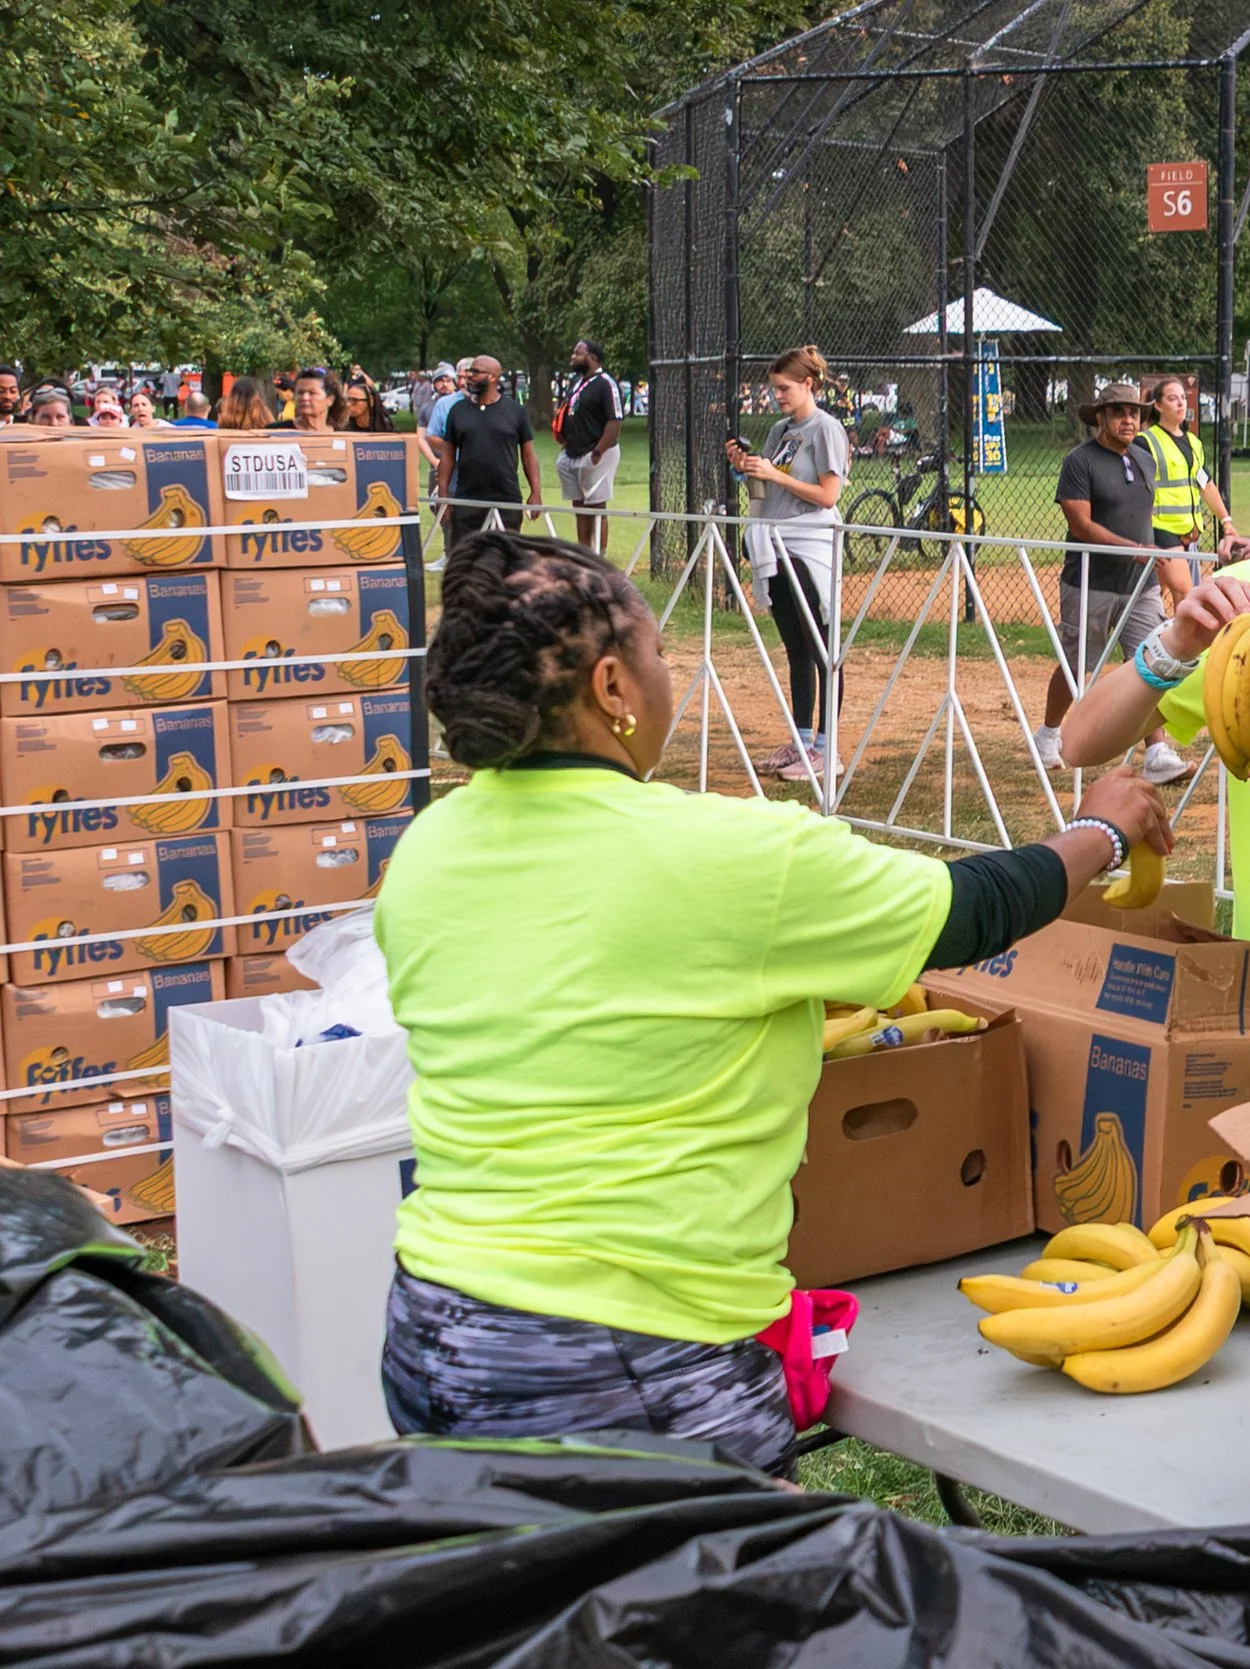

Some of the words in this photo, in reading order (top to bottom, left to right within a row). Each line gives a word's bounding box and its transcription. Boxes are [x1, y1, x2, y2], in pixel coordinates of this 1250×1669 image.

[1161, 170, 1193, 181] FIELD
[1163, 190, 1192, 217] S6
[146, 449, 204, 463] Bananas
[356, 447, 405, 462] Bananas
[232, 454, 298, 473] STDUSA
[149, 583, 206, 598] Bananas
[360, 576, 408, 590] Banana
[363, 701, 411, 716] Banana
[156, 716, 212, 732] Bananas
[159, 844, 217, 861] Bananas
[154, 969, 211, 989] Bananas
[1091, 1044, 1149, 1081] Bananas
